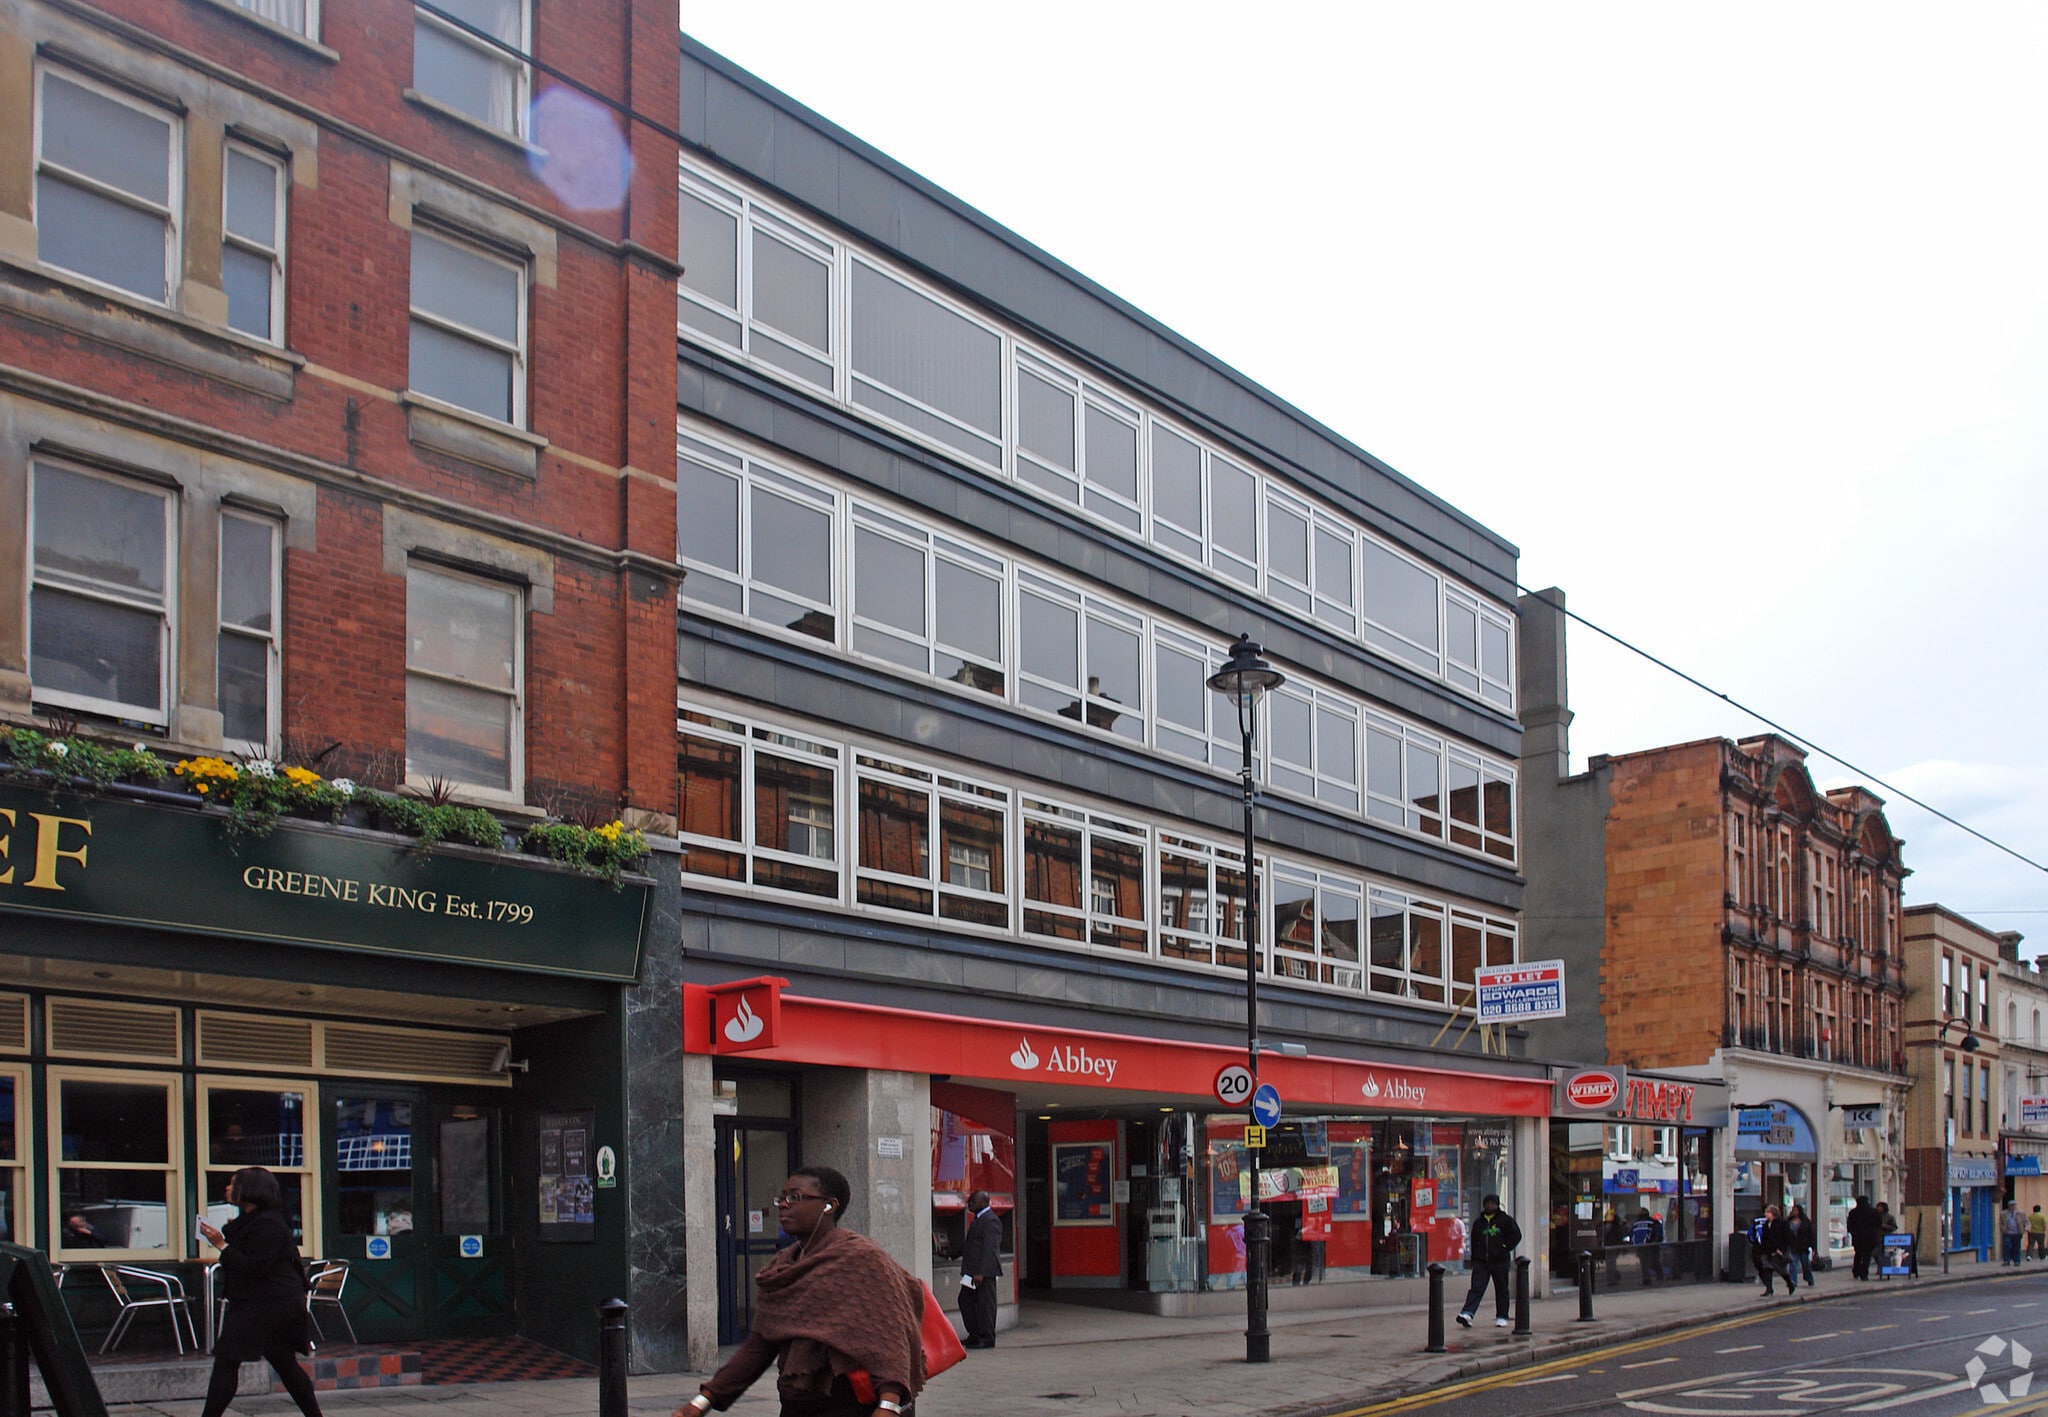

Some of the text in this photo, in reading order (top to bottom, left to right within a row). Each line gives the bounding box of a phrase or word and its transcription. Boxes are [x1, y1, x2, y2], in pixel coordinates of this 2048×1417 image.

[242, 865, 360, 902] GREENE
[367, 882, 437, 913] KING
[1494, 974, 1513, 985] TO
[1518, 971, 1544, 983] LET
[1482, 987, 1558, 1001] EDWARDS
[1483, 1005, 1502, 1015] 020
[1534, 1000, 1558, 1010] 8313
[1046, 1045, 1118, 1083] Abbey
[1220, 1075, 1249, 1095] 20
[1383, 1077, 1426, 1106] Abbey
[1570, 1084, 1615, 1096] WIMPY
[1853, 1110, 1873, 1122] ICE
[1675, 1378, 1907, 1403] 20
